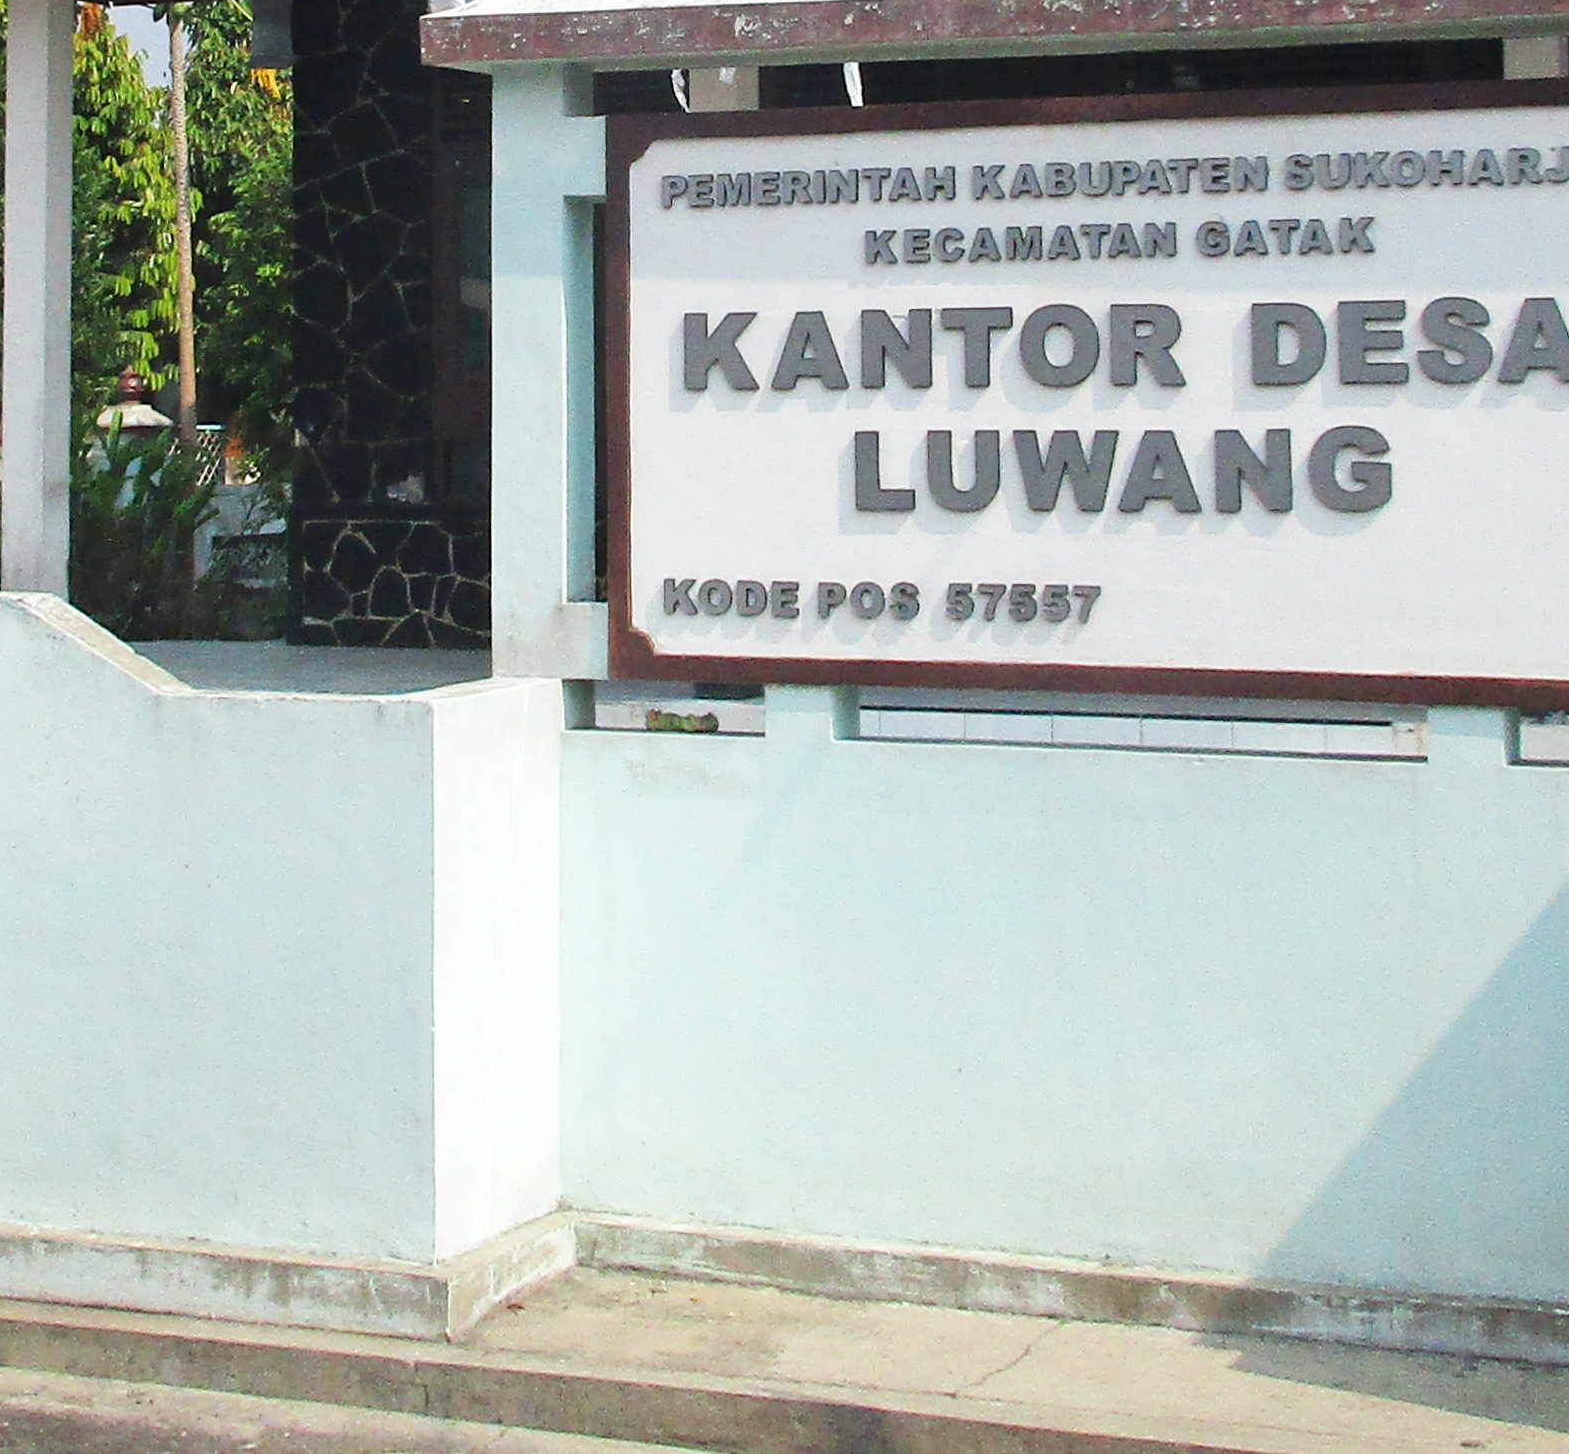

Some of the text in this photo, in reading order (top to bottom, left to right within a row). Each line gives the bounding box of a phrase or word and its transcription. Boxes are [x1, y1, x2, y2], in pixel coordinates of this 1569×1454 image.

[661, 165, 956, 209] PEMERINTAH
[971, 156, 1270, 200] KABUPATEN
[864, 216, 1376, 265] KECAMATAN GATAK
[680, 301, 1187, 393] KANTOR
[852, 423, 1395, 515] LUWANG
[661, 576, 1103, 625] KODE POS 57557
